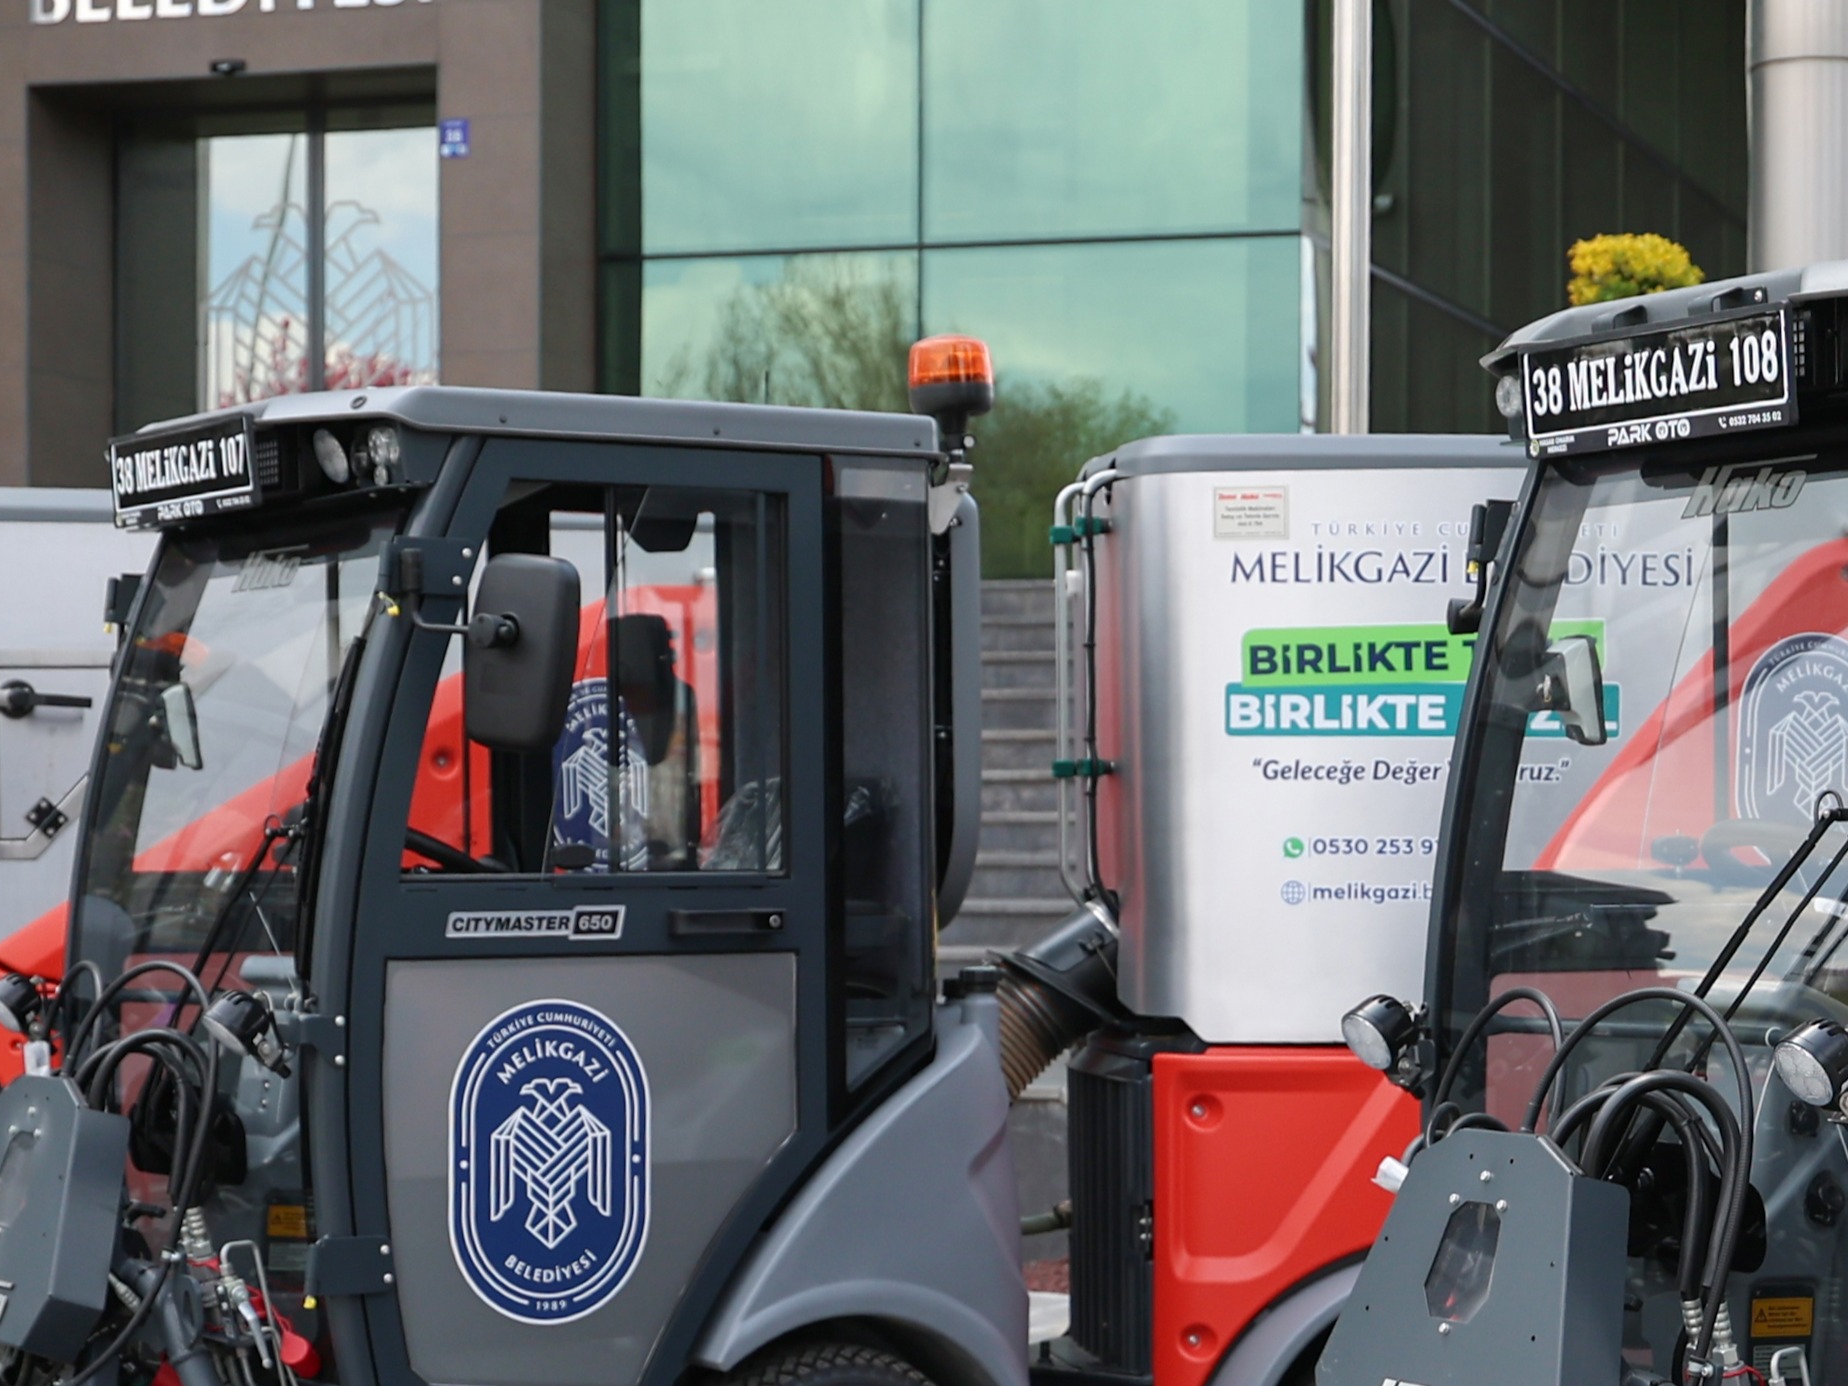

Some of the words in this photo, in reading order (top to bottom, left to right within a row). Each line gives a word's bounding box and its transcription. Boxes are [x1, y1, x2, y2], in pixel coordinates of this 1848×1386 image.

[1532, 367, 1563, 416] 38
[1729, 330, 1779, 386] 108
[1608, 423, 1652, 446] PARK
[1655, 419, 1691, 441] OTO
[116, 456, 134, 494] 38
[220, 433, 244, 477] 107
[1681, 454, 1818, 519] Hako
[158, 503, 183, 520] PARK
[1312, 521, 1420, 537] TÜRKİYE
[1231, 544, 1447, 583] MELİKGAZİ
[1373, 759, 1442, 785] Değer
[1313, 839, 1368, 854] 0530
[1376, 839, 1414, 854] 253
[1421, 839, 1439, 854] 9
[452, 915, 570, 932] CITYMASTER
[578, 914, 612, 930] 650
[486, 1013, 534, 1049] TÜRKİYE
[536, 1011, 617, 1048] CUMHURİYETİ
[496, 1037, 610, 1085] MELİKGAZİ
[504, 1249, 598, 1283] BELEDİYESİ
[536, 1299, 567, 1311] 1989
